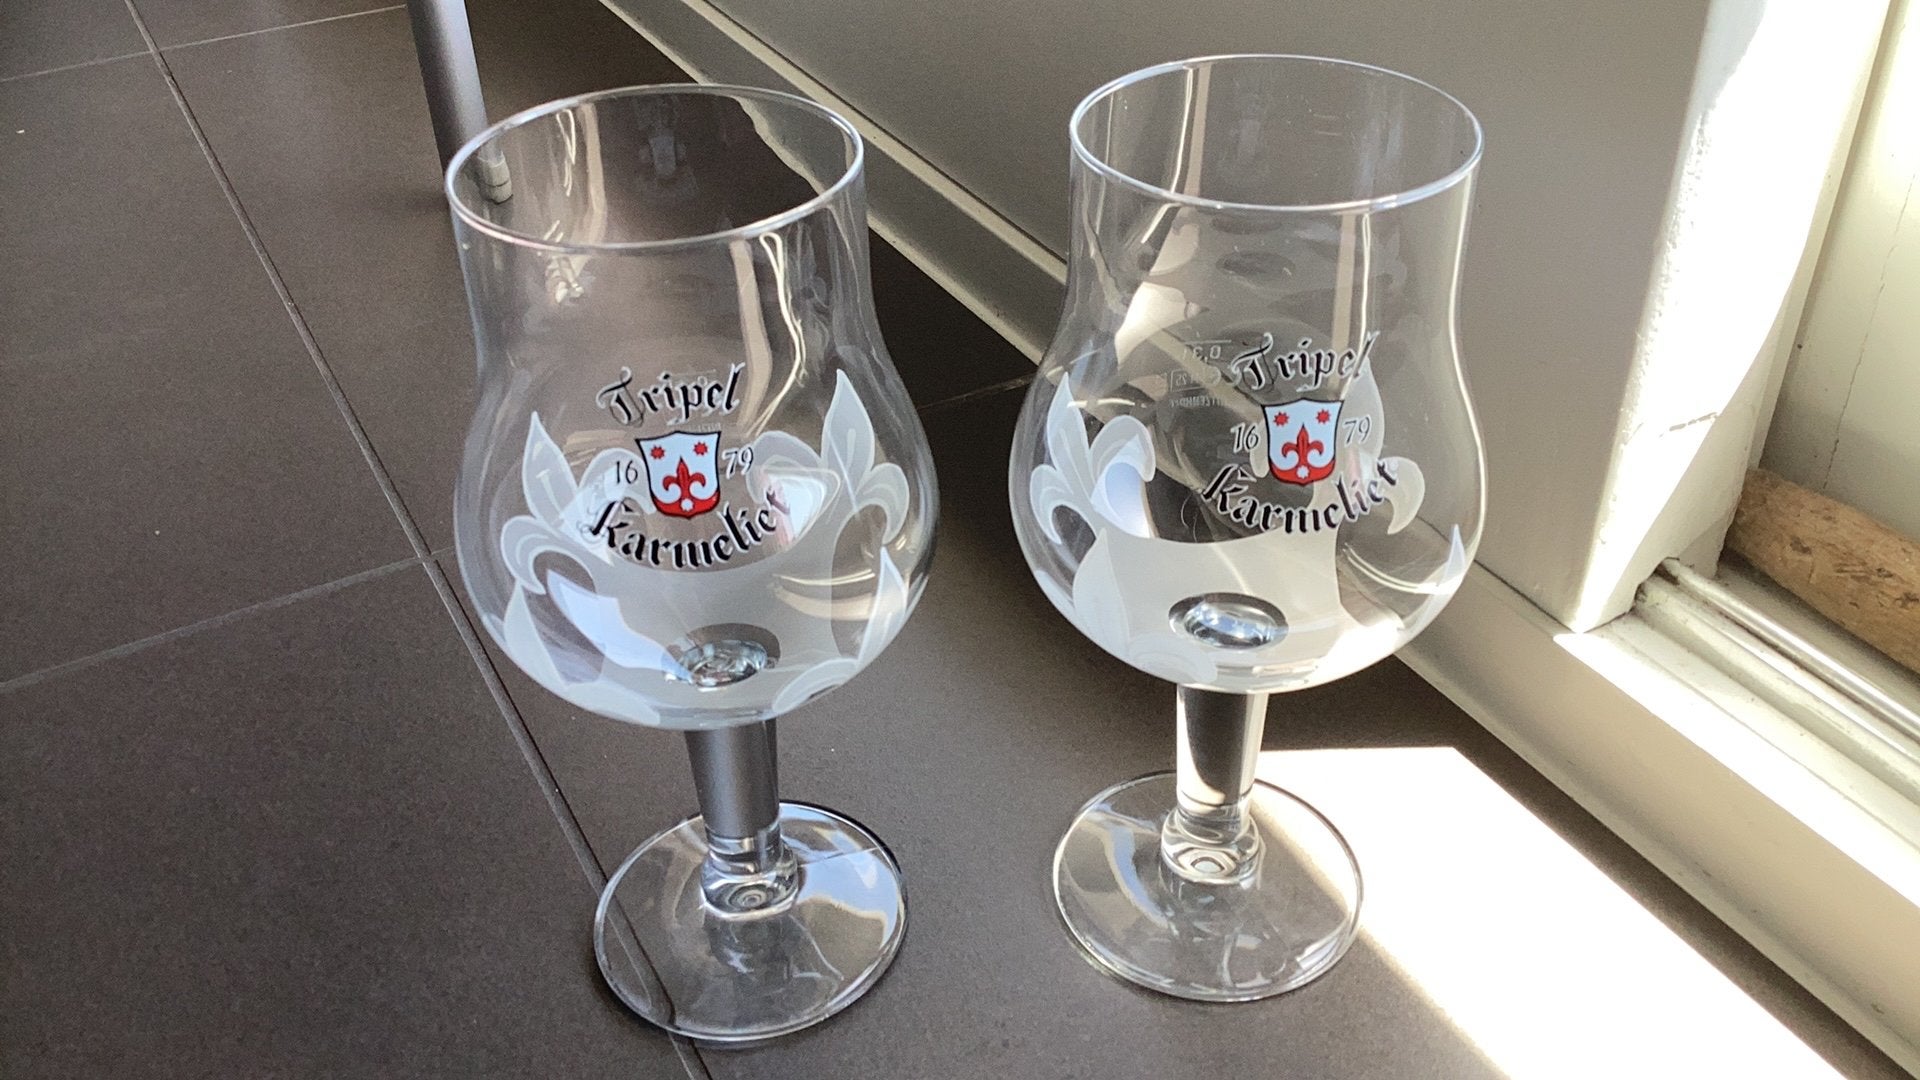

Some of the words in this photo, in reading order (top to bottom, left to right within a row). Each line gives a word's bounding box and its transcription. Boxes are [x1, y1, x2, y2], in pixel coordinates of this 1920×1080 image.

[1229, 331, 1381, 392] Tripel
[596, 362, 746, 427] Tripel
[1231, 422, 1261, 453] 16
[1343, 414, 1373, 445] 79
[614, 459, 639, 485] 16
[722, 446, 755, 480] 79
[1200, 456, 1398, 534] Karmeliet
